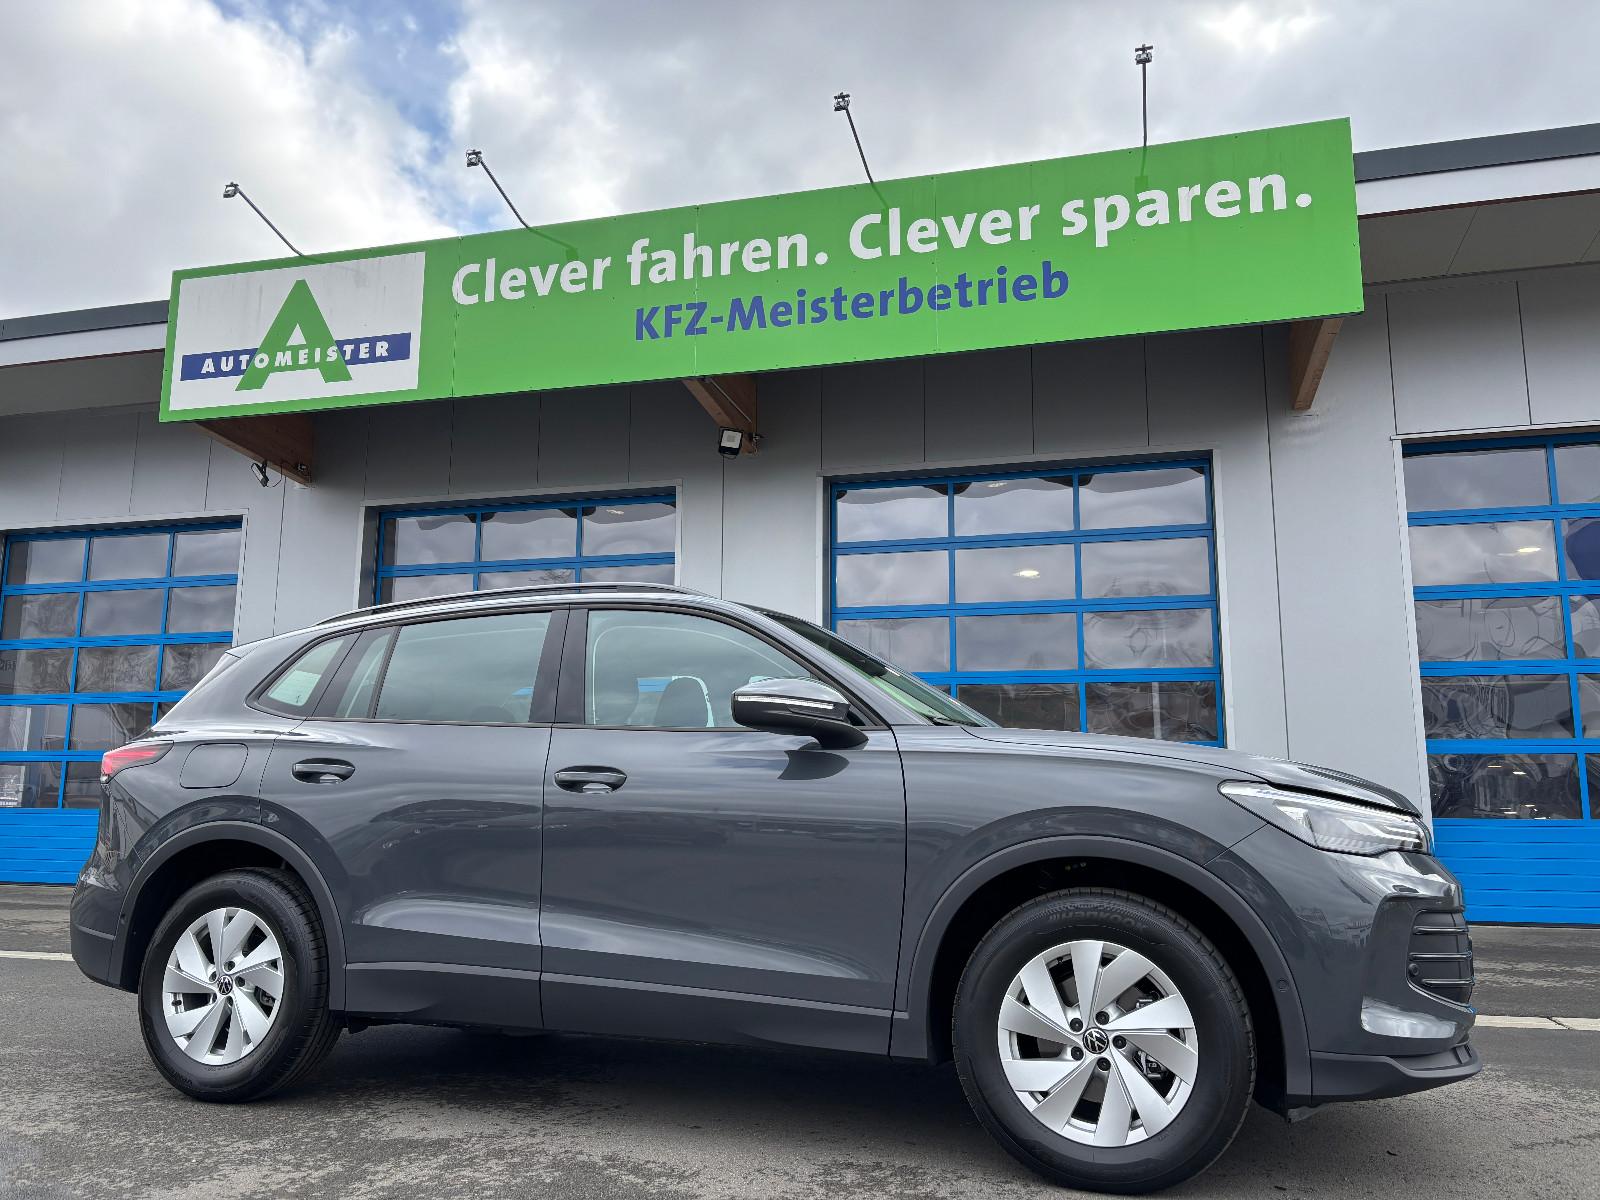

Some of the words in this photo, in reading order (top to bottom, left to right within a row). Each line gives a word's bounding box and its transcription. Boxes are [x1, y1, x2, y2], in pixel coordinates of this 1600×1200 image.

[452, 256, 612, 306] Clever
[627, 231, 829, 287] fahren.
[849, 204, 1041, 261] Clever
[1061, 172, 1313, 249] sparen.
[635, 260, 1070, 341] KFZ-Meisterbetrieb
[200, 340, 389, 374] AUTOMEISTER
